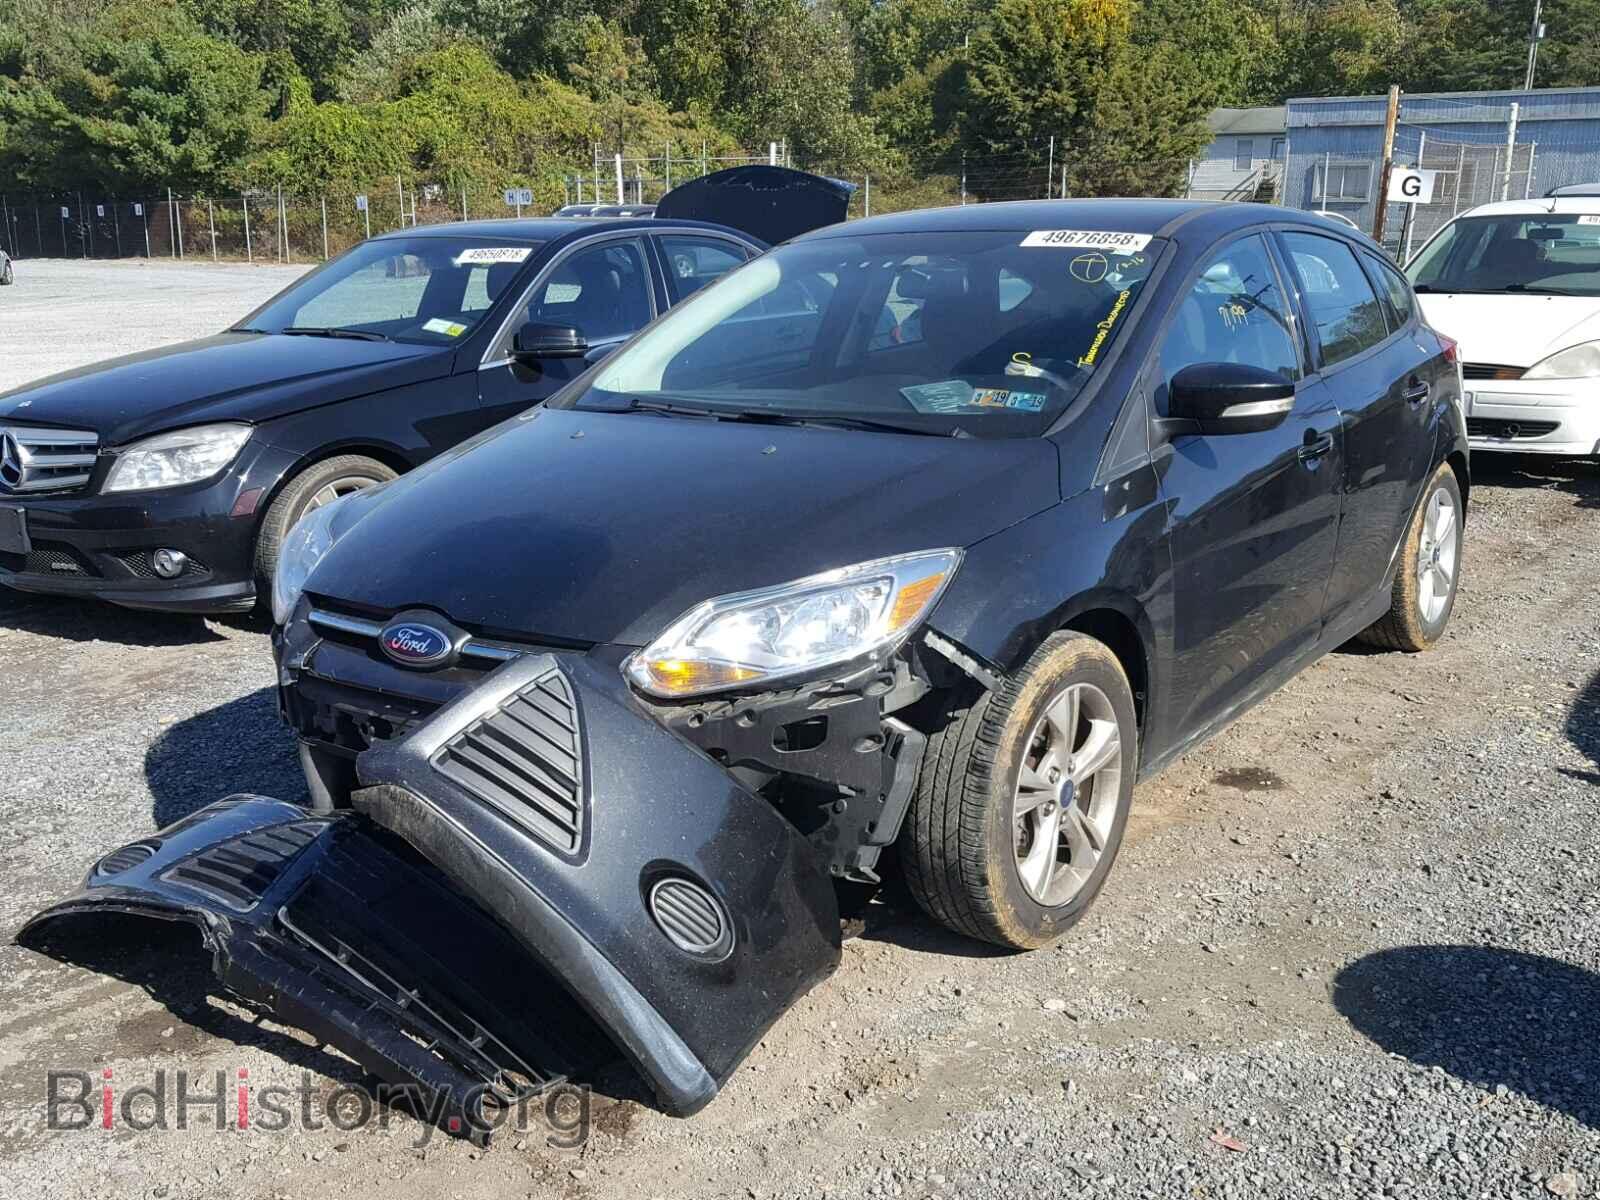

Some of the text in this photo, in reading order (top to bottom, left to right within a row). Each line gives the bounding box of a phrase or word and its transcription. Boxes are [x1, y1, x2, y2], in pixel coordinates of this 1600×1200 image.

[1401, 175, 1422, 197] G
[1042, 231, 1135, 246] 49676858
[391, 628, 432, 654] Ford
